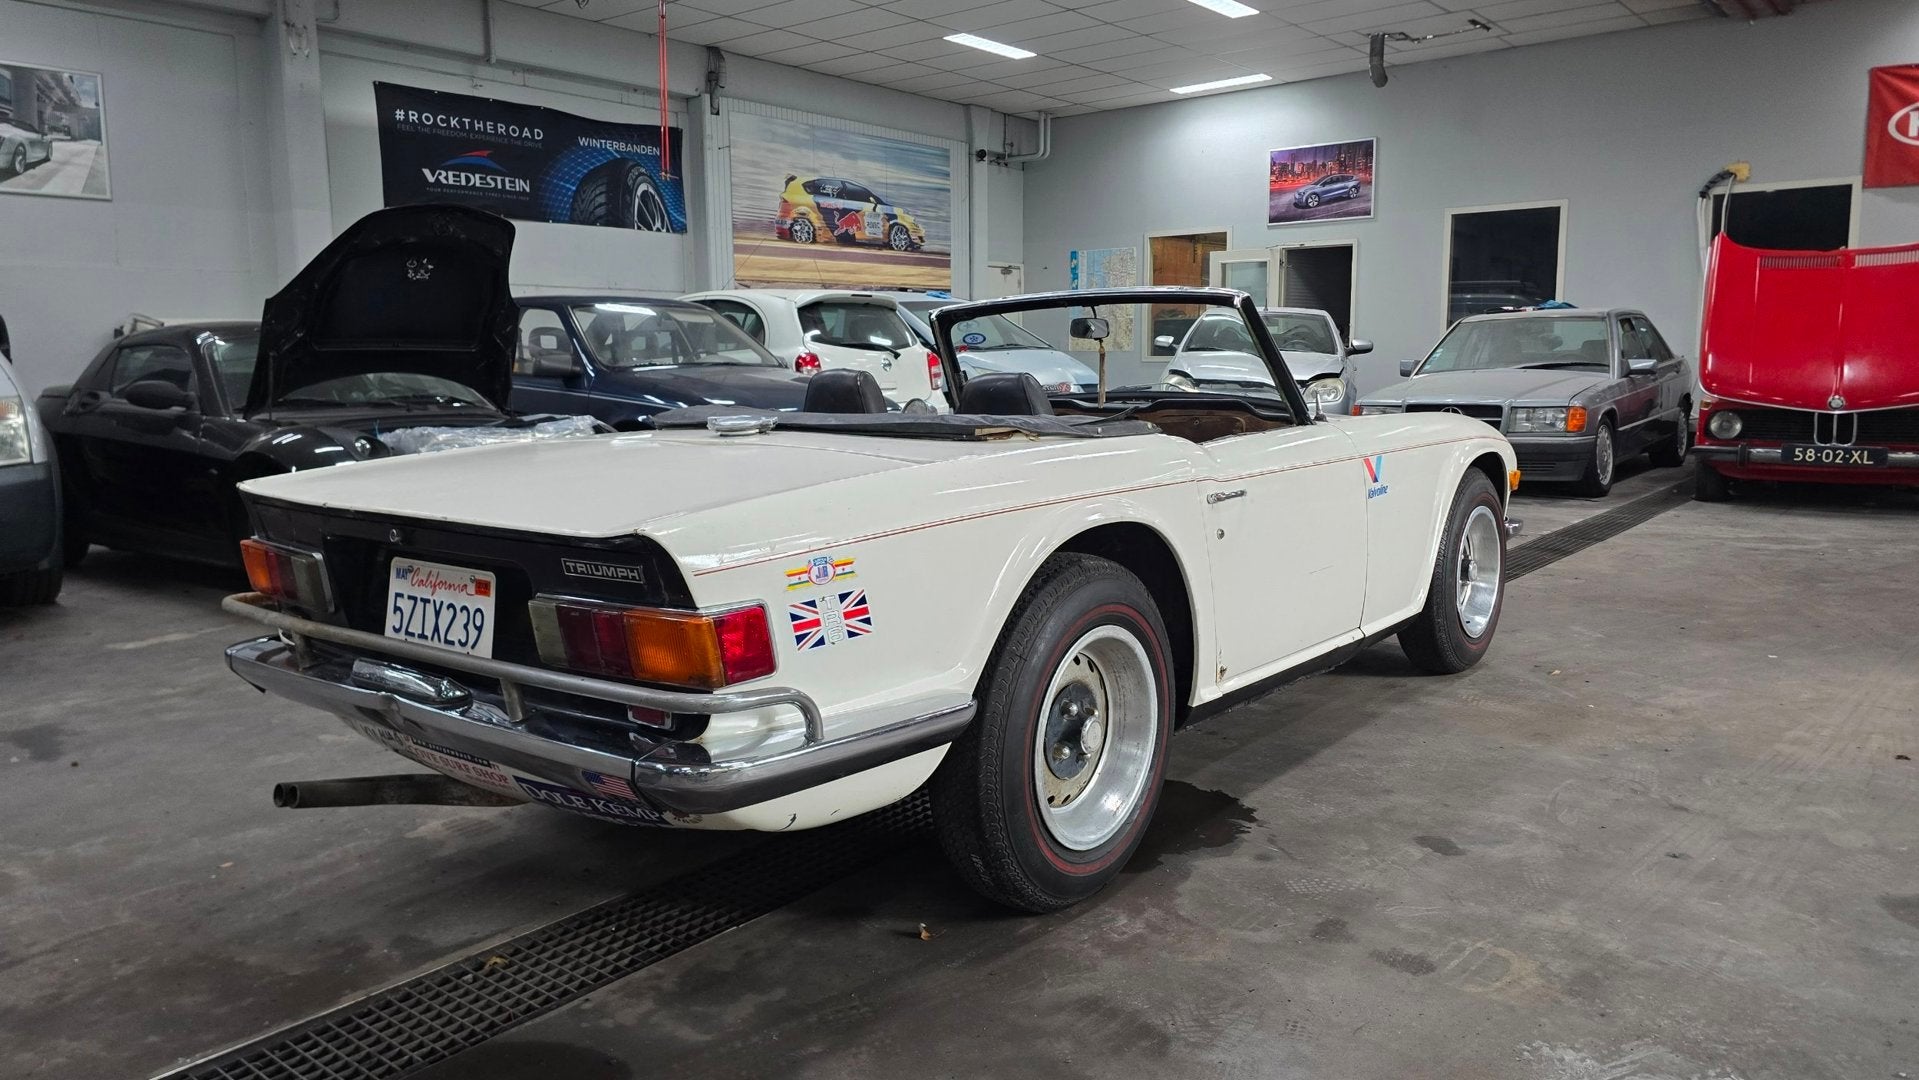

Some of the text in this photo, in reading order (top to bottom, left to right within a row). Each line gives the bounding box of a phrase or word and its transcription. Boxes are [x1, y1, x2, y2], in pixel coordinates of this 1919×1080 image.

[395, 108, 543, 141] #ROCKTHEROAD
[397, 123, 415, 132] FEEL
[418, 126, 431, 135] THE
[578, 136, 660, 156] WINTERBANDEN
[422, 168, 530, 193] VREDESTEIN
[1793, 447, 1874, 465] 58-02-XL
[410, 566, 475, 597] California
[565, 562, 640, 580] TRIUMPH
[391, 592, 485, 650] 5ZIX239
[471, 766, 512, 785] SHOP
[519, 782, 661, 821] DOLE KEMP
